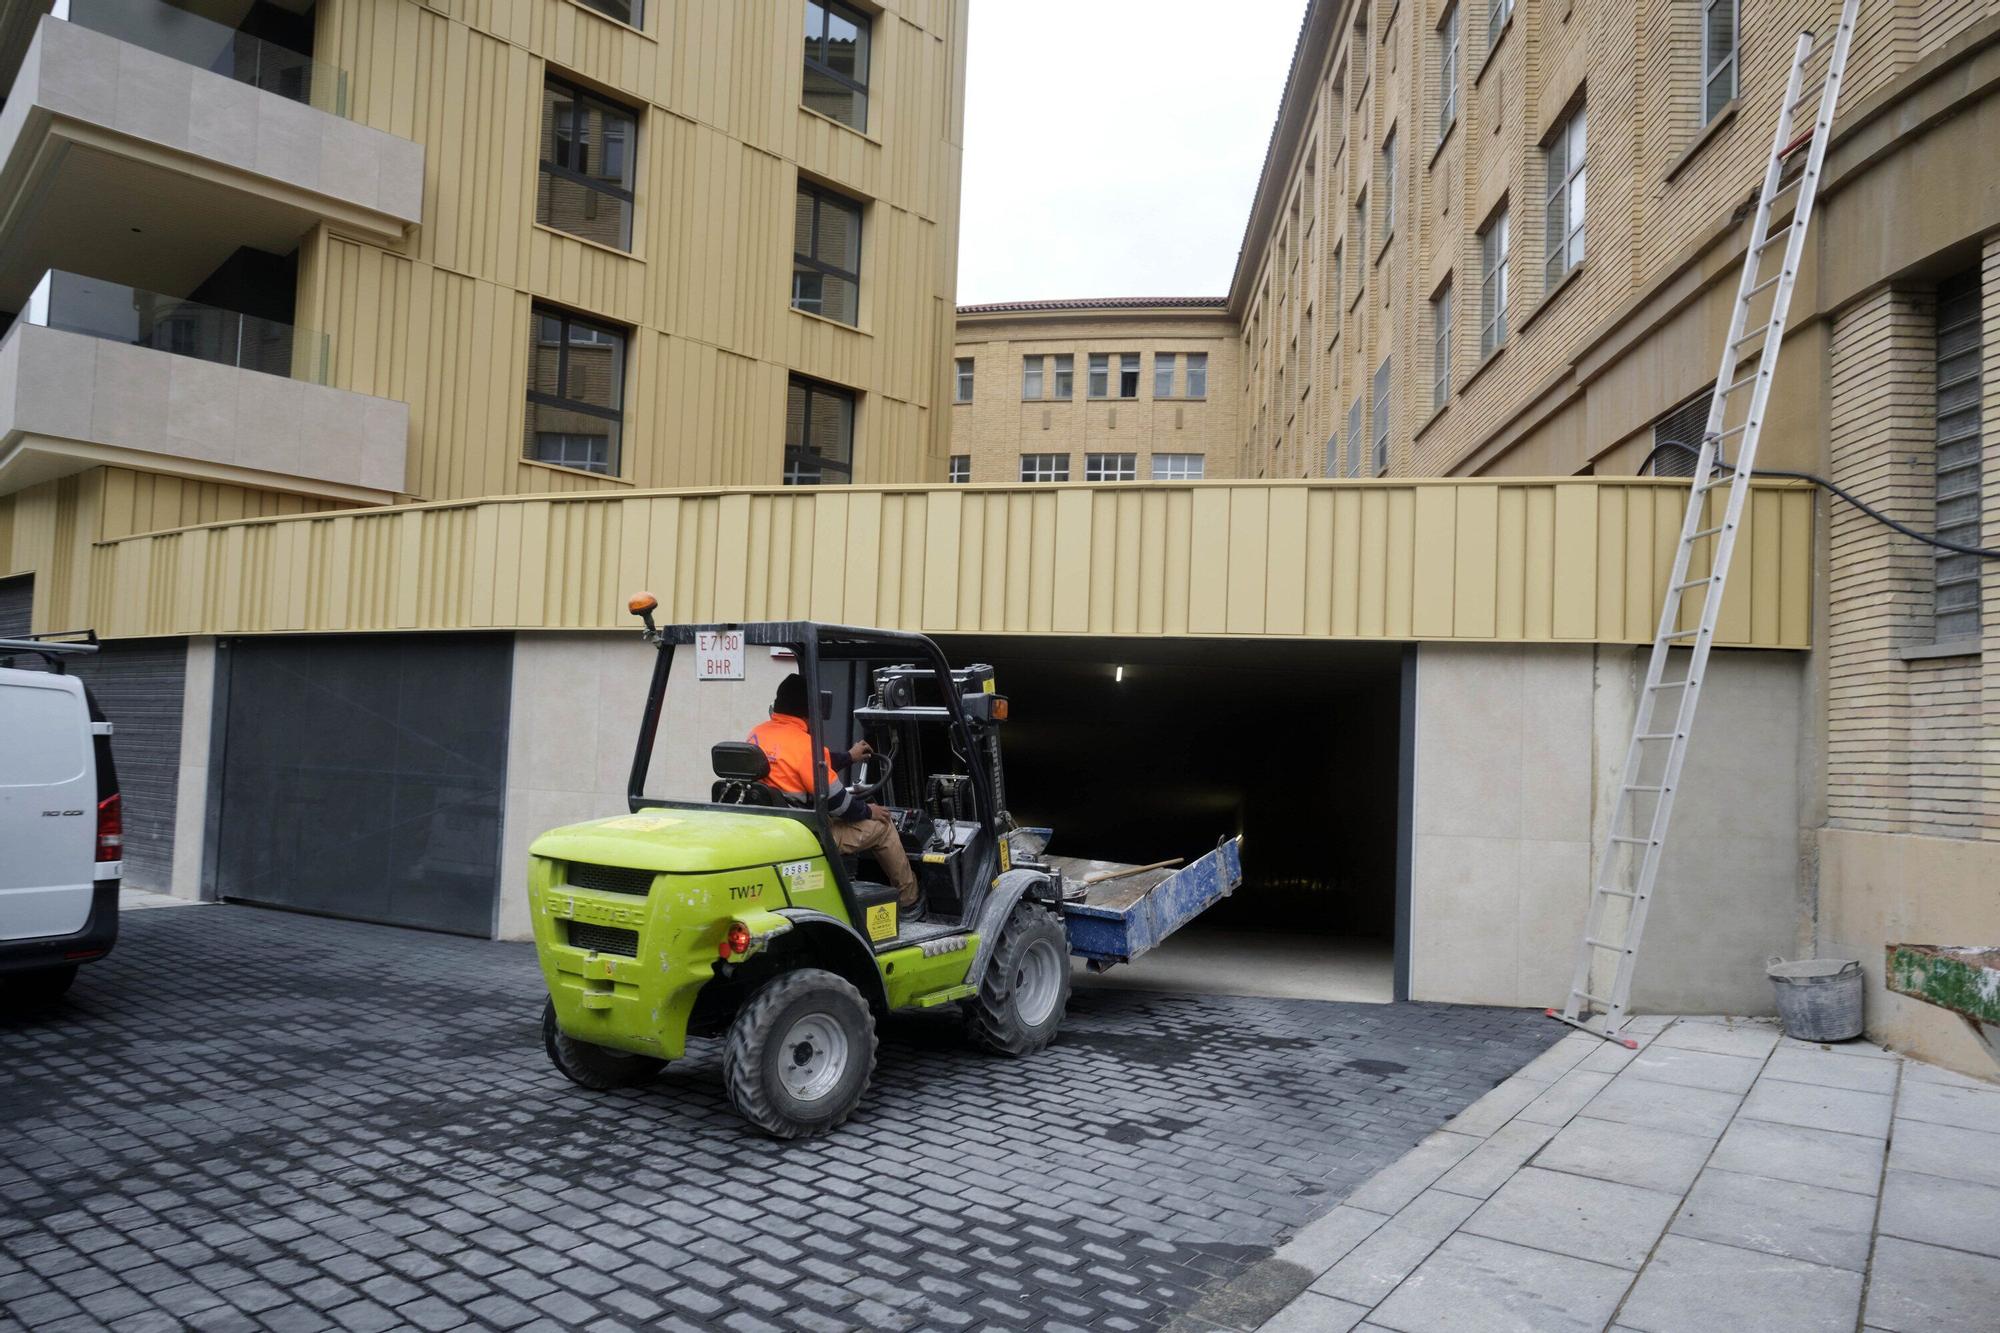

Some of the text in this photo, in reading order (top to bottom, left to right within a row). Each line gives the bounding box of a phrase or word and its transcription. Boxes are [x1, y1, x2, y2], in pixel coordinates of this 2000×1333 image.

[699, 635, 738, 651] E 7130
[707, 659, 731, 675] BHR
[728, 884, 763, 900] TW17
